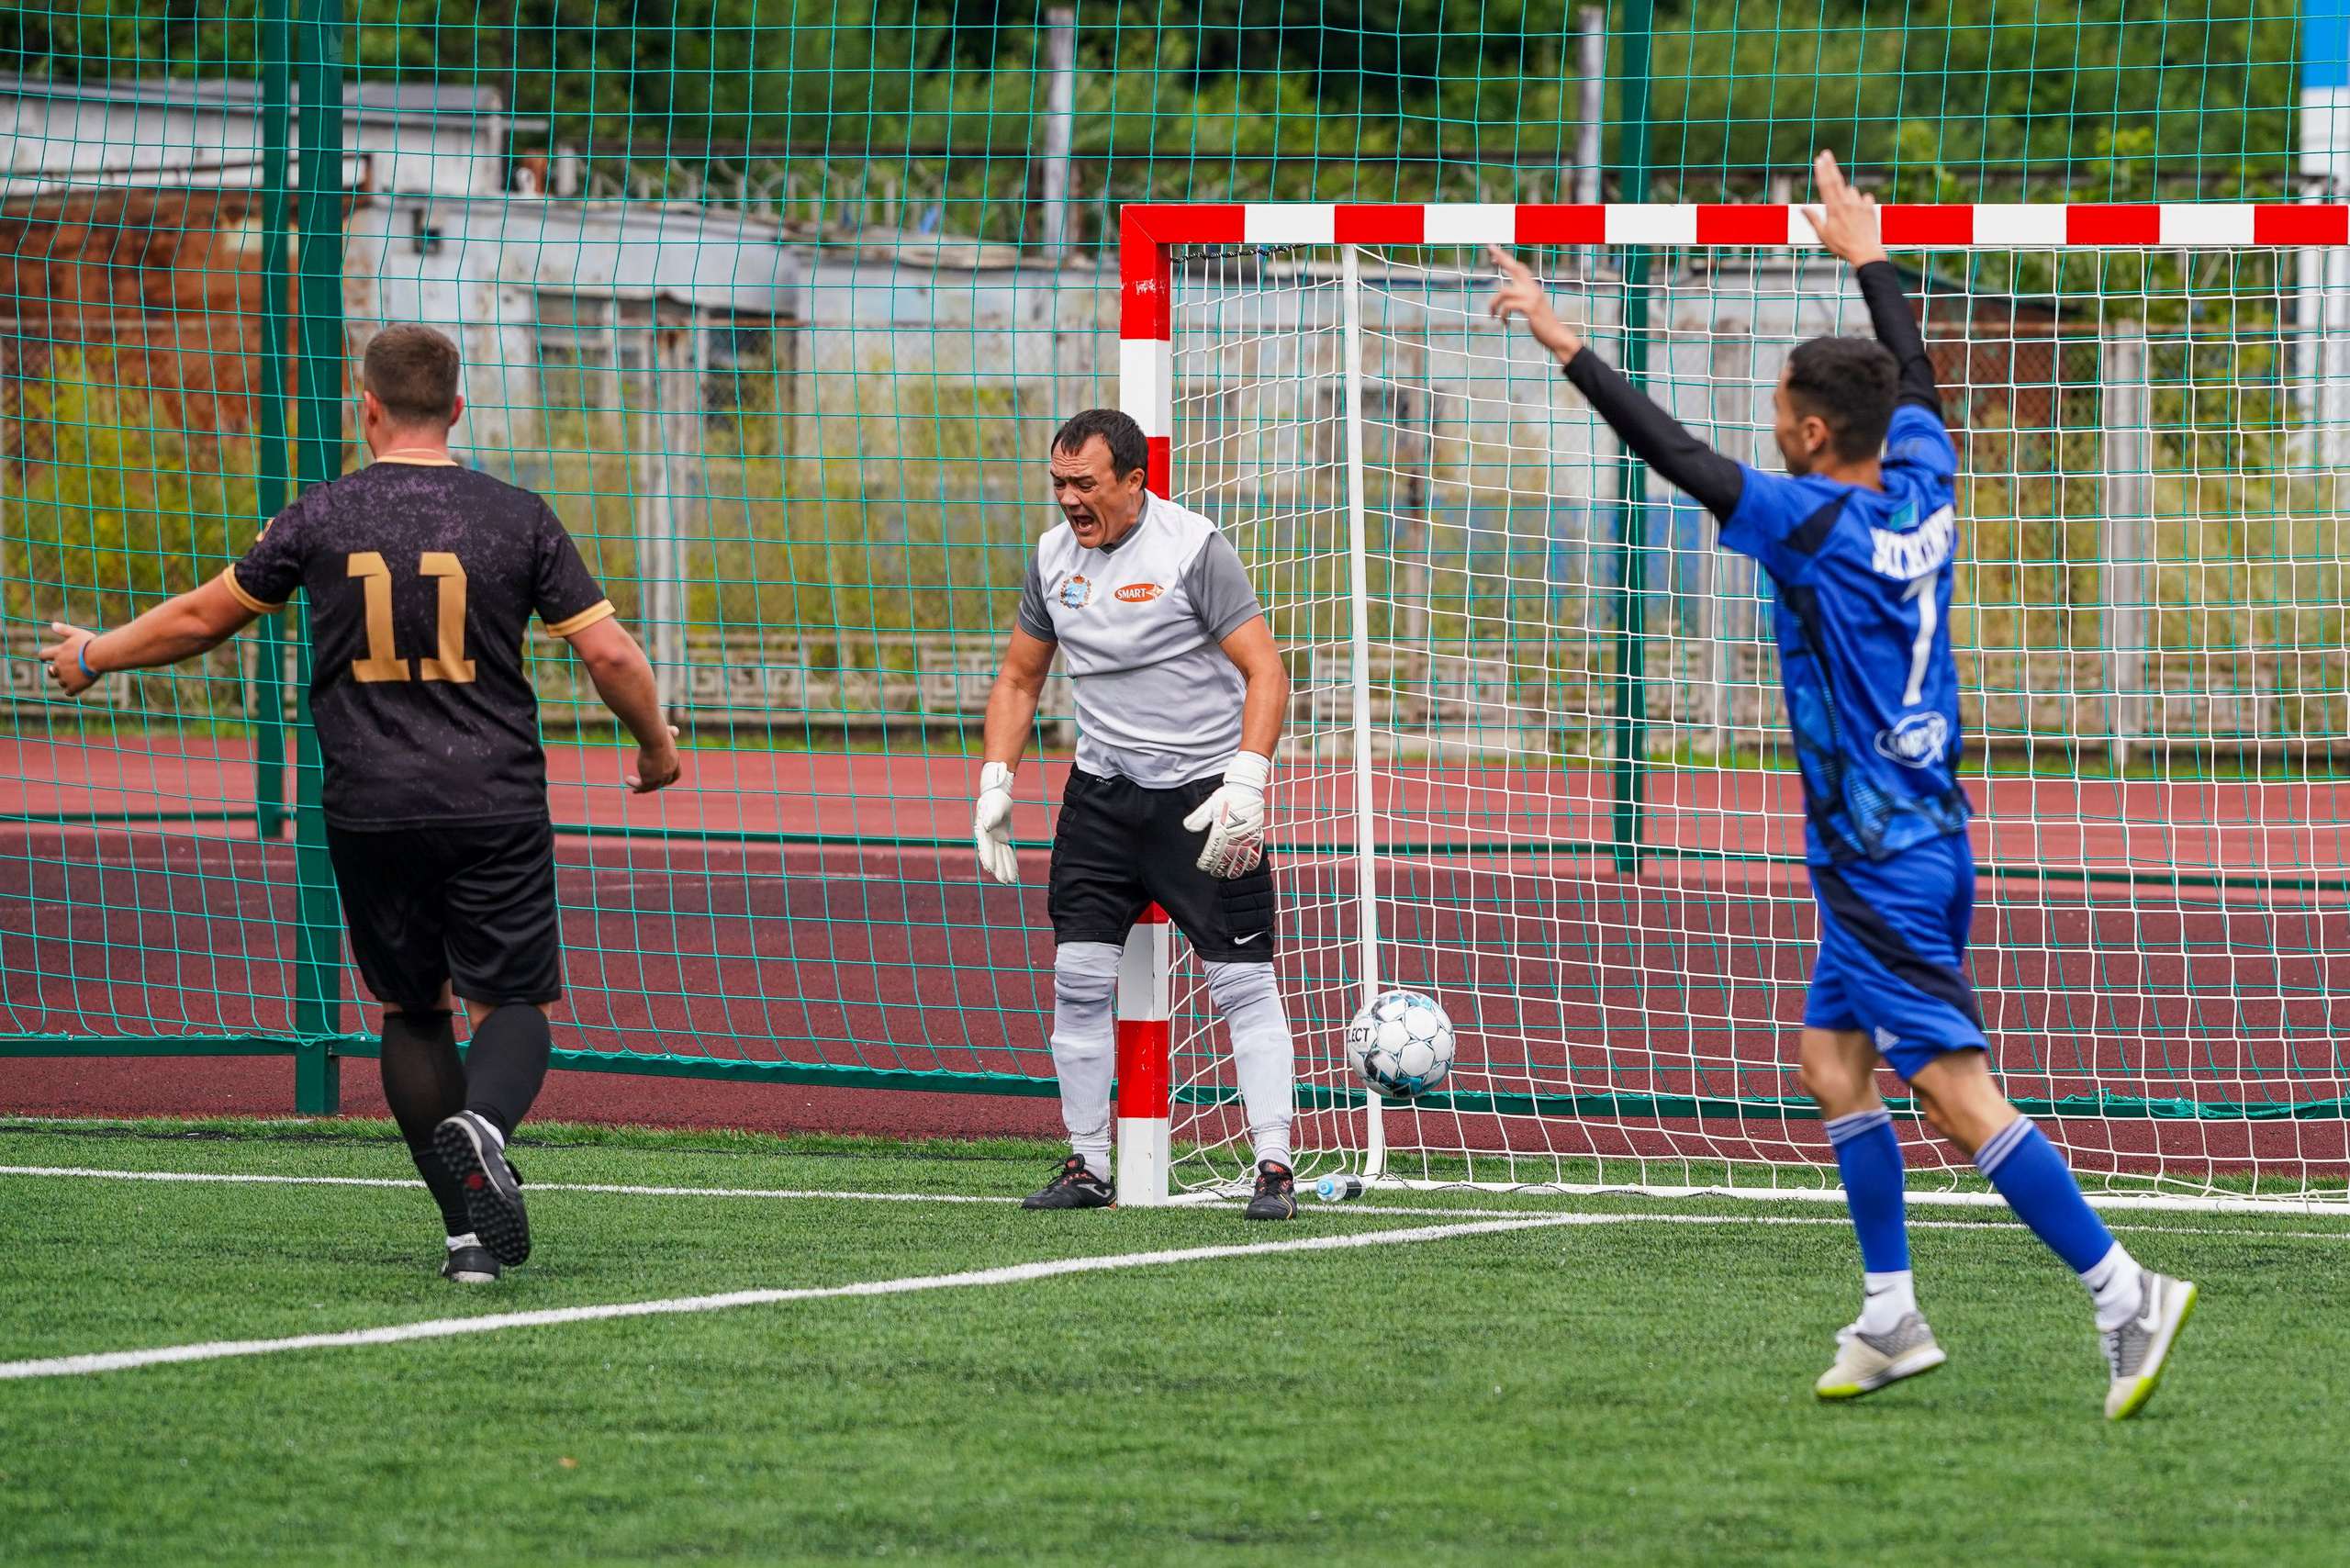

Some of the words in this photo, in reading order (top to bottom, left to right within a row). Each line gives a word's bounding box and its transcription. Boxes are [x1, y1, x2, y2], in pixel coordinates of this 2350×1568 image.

[1117, 588, 1147, 599] SMART
[346, 551, 476, 683] 11
[1348, 1027, 1370, 1042] LECT
